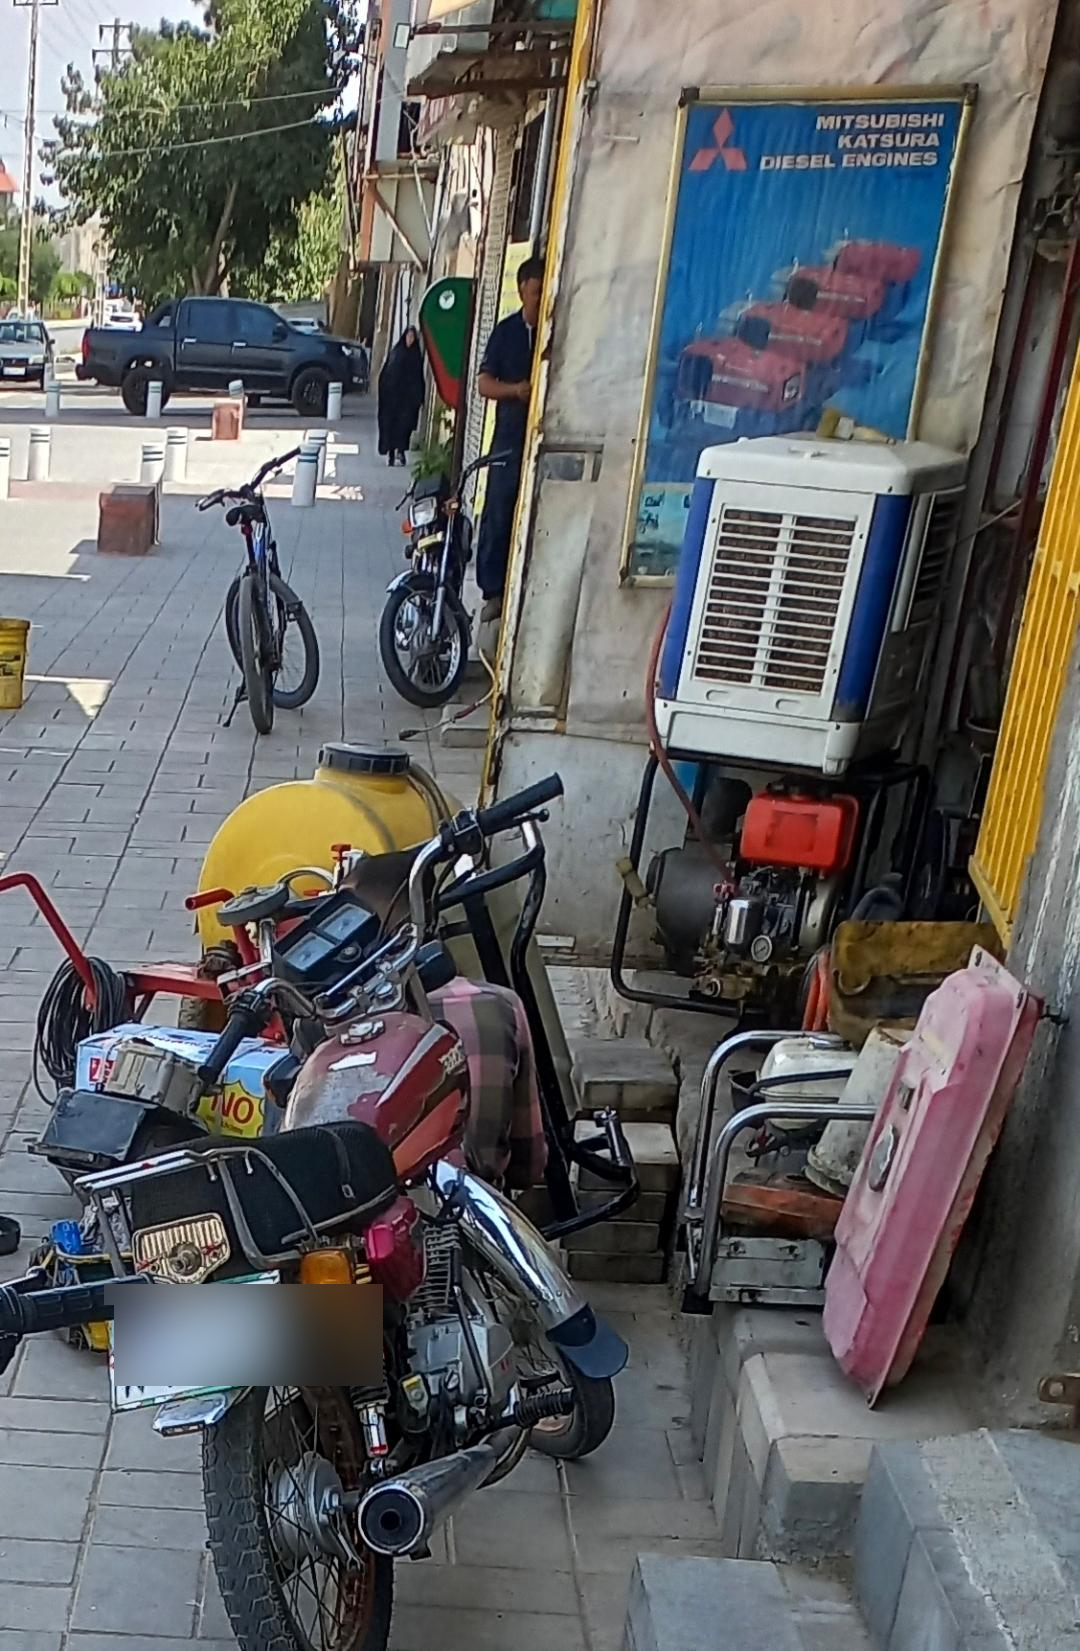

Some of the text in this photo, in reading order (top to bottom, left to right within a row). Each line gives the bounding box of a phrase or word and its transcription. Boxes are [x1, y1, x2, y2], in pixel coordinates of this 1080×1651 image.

[816, 113, 945, 130] MITSUBISHI
[837, 133, 940, 149] KATSURA
[760, 152, 937, 170] DIESEL ENGINES
